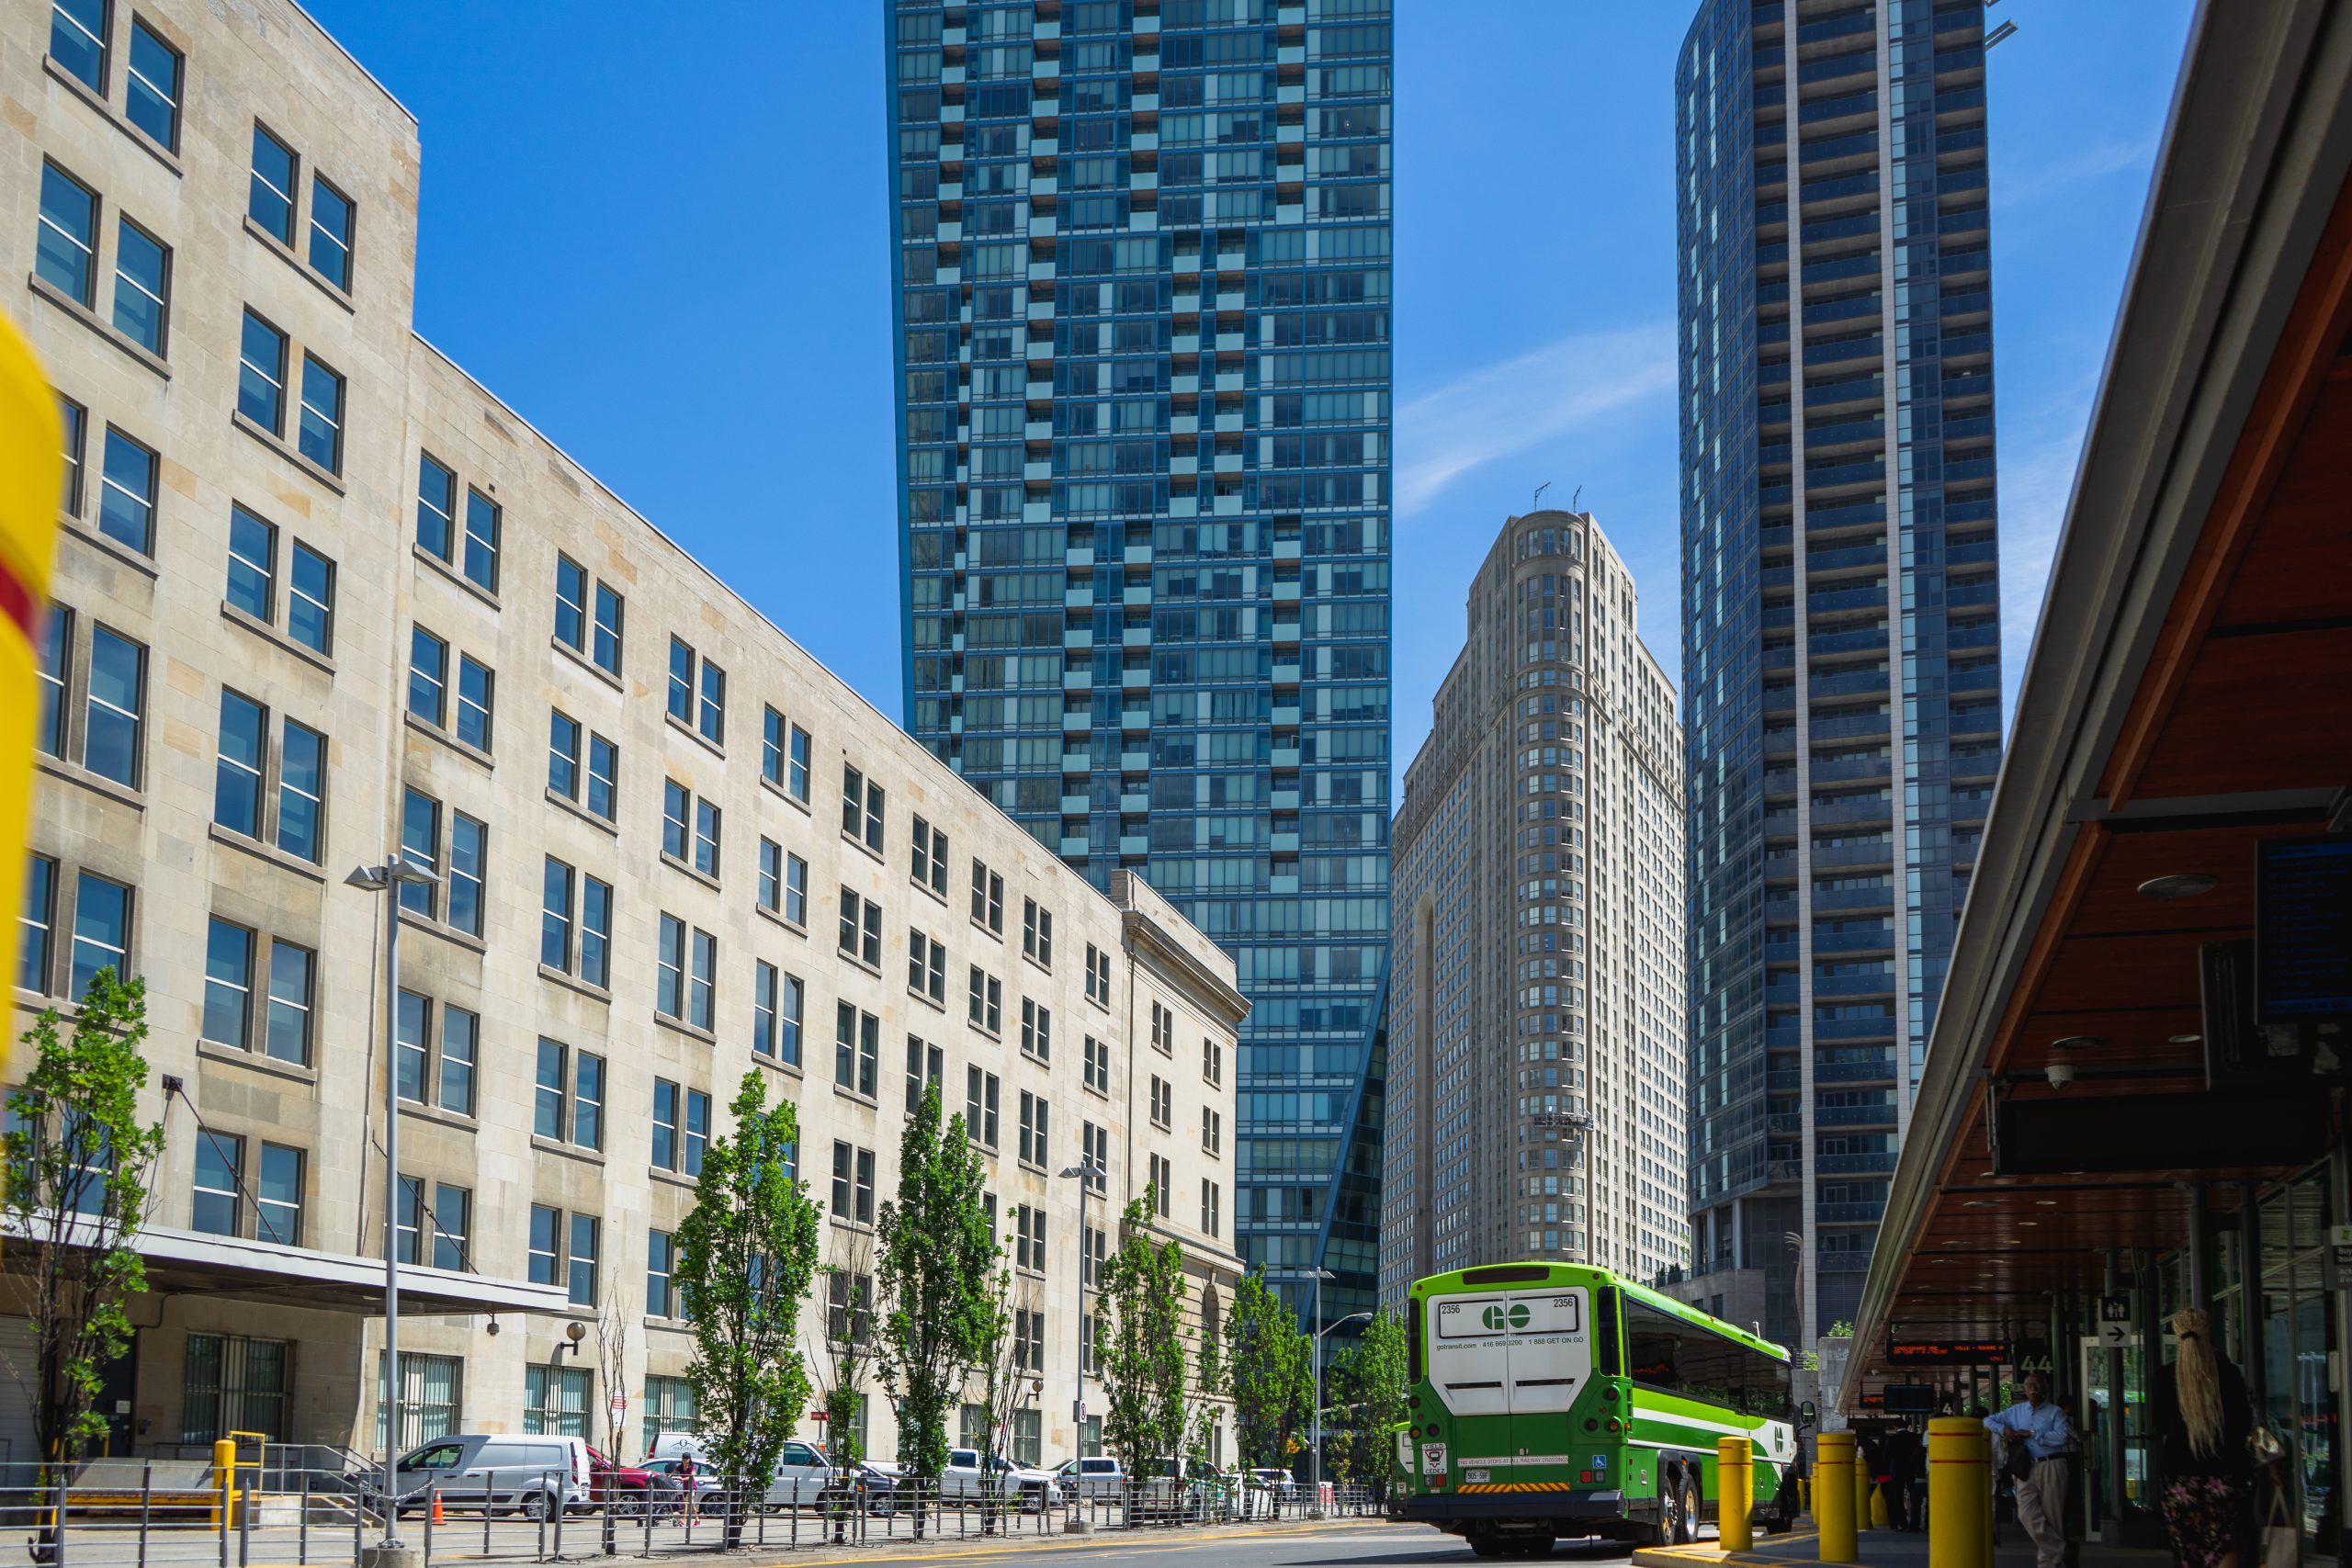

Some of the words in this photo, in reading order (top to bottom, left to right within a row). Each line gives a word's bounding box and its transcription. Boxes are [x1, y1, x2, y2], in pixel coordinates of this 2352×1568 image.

[1553, 1297, 1573, 1308] 2356
[1442, 1304, 1461, 1314] 2356
[1482, 1303, 1531, 1330] GO
[1436, 1342, 1477, 1351] gotransit.com
[1495, 1339, 1507, 1348] 869
[1507, 1338, 1522, 1347] 3200
[2020, 1355, 2053, 1375] 44
